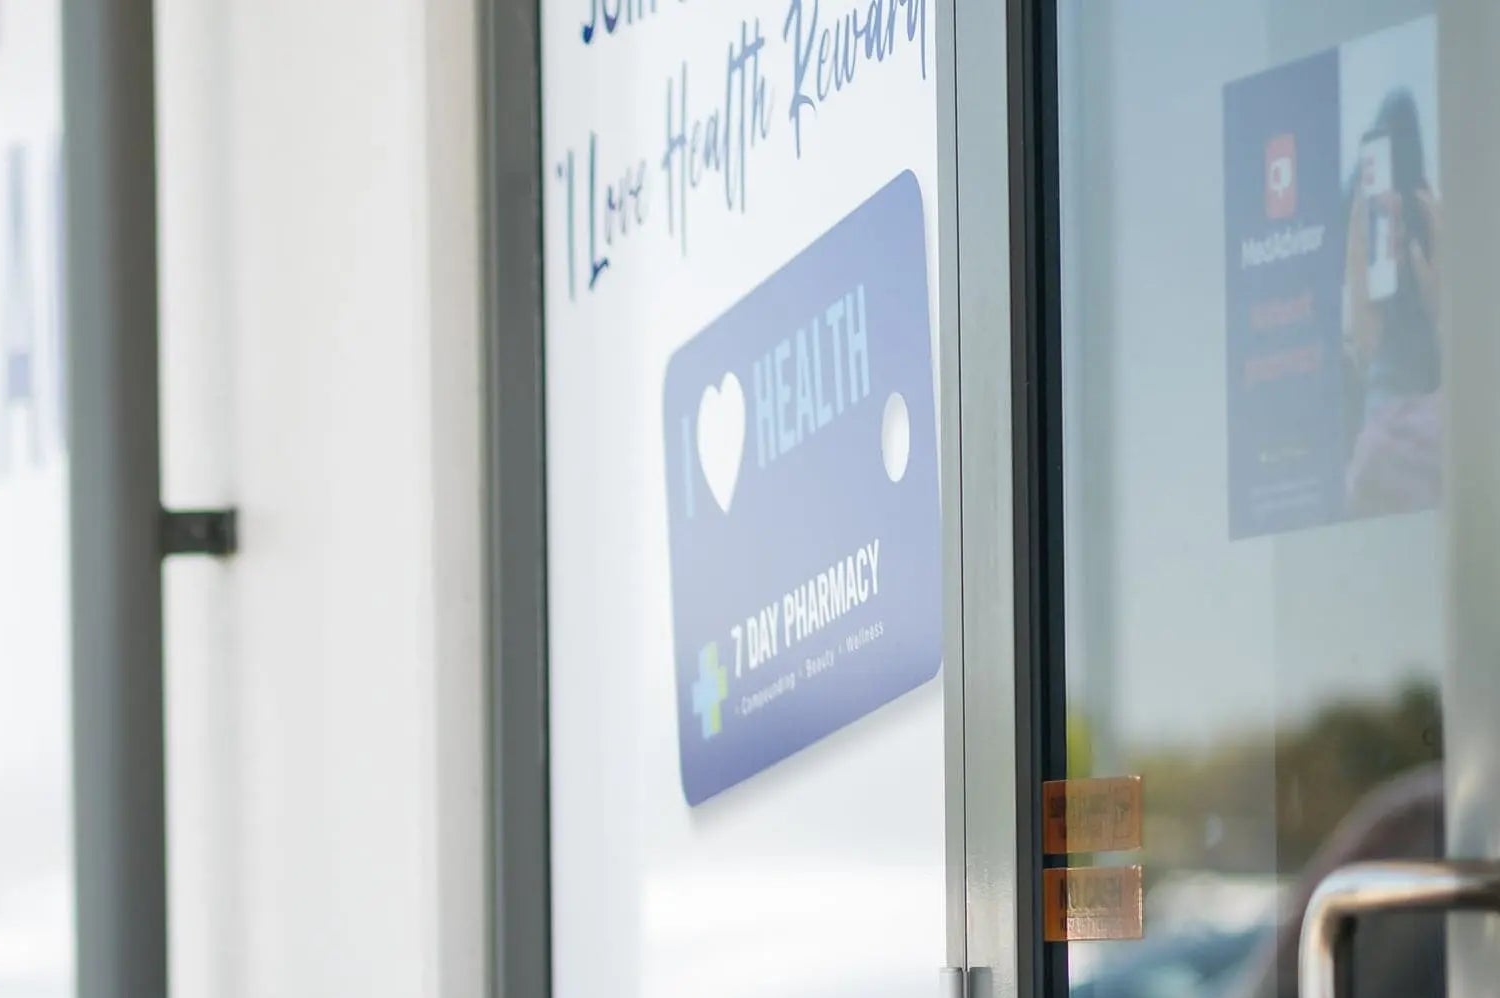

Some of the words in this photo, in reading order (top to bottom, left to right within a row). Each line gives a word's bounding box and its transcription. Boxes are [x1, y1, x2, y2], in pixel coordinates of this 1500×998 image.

[588, 130, 647, 290] Love
[662, 17, 775, 257] Health
[681, 414, 695, 519] I
[753, 283, 870, 469] HEALTH
[730, 624, 743, 678] 7
[746, 601, 779, 670] DAY
[784, 538, 882, 649] PHARMACY
[845, 620, 885, 654] Wellness
